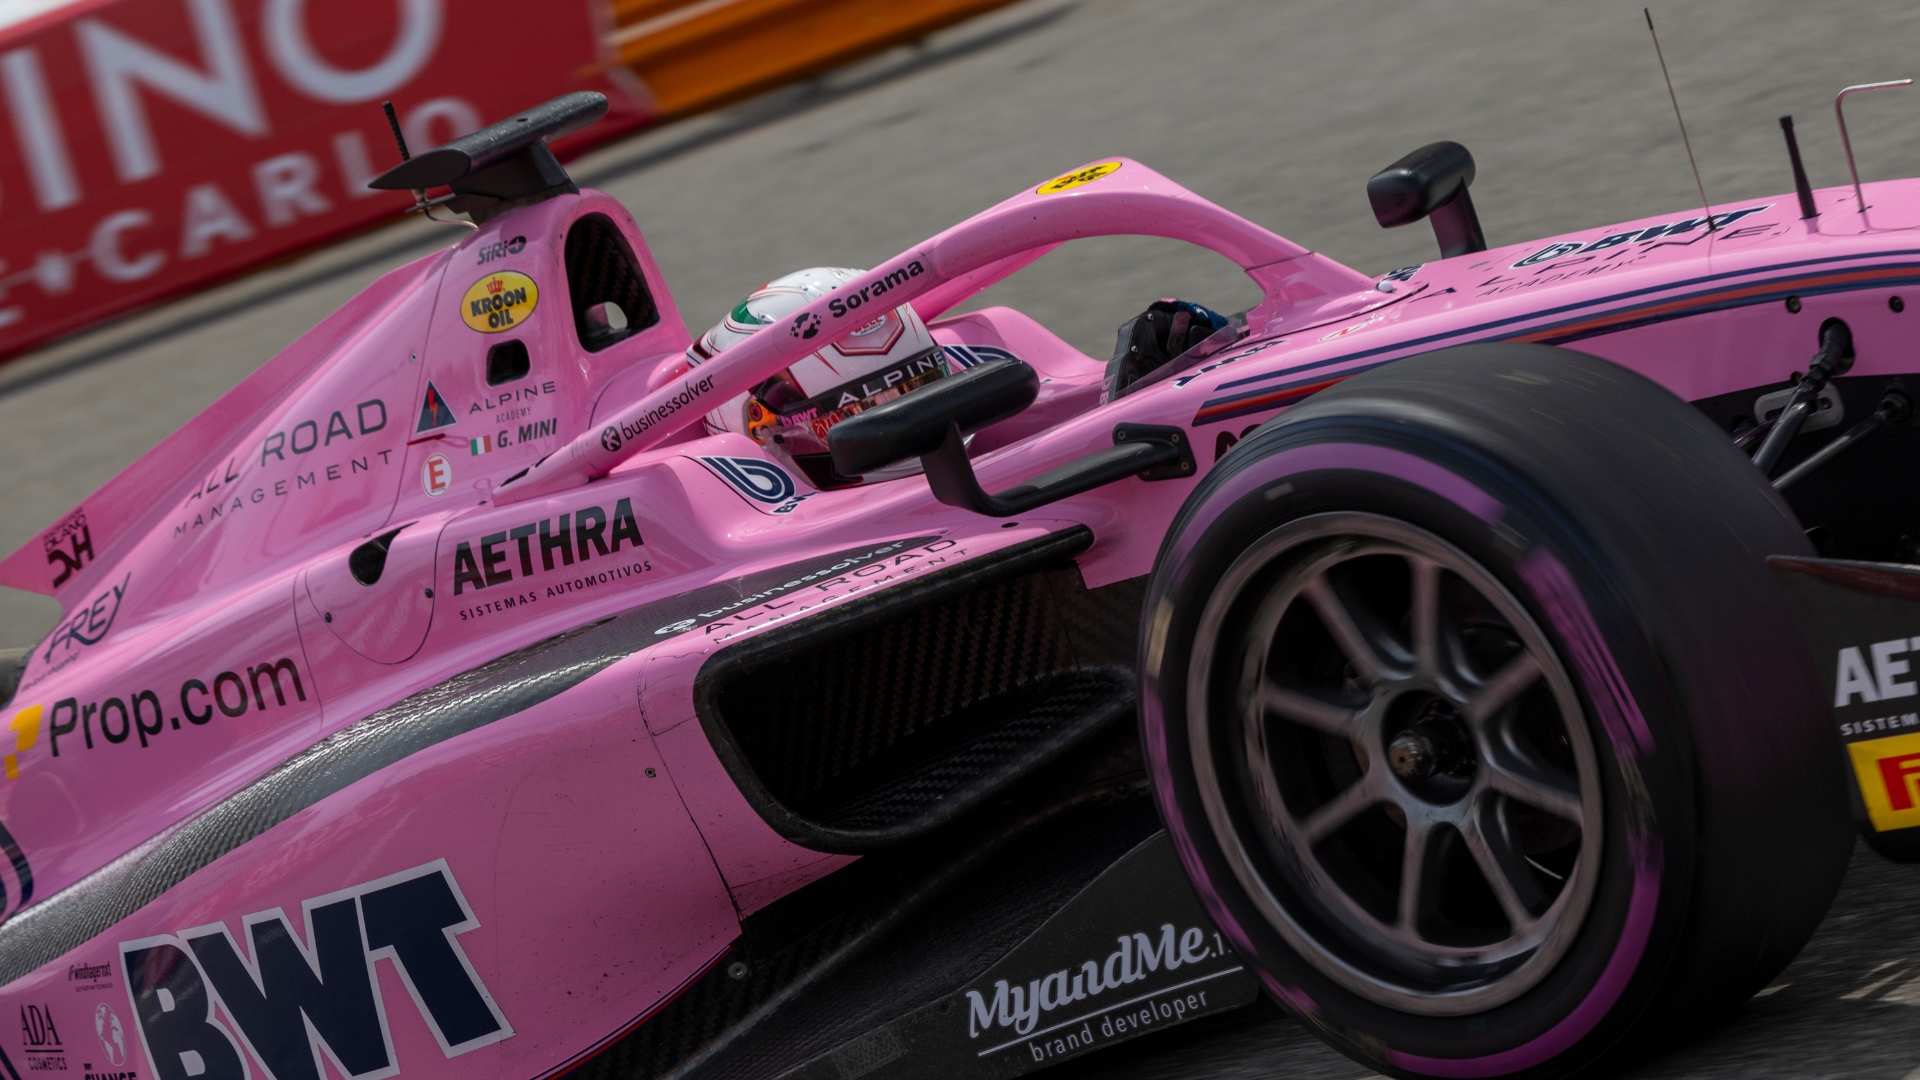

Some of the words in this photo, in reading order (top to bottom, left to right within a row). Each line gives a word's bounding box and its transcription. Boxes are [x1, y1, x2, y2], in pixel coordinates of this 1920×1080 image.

[1573, 203, 1777, 256] BWT
[470, 286, 528, 317] KROON
[828, 259, 925, 318] Sorama
[488, 309, 514, 329] OIL
[469, 381, 556, 414] ALPINE
[620, 374, 715, 441] businessolver
[837, 351, 944, 409] ALPINE
[260, 398, 388, 468] ROAD
[496, 406, 532, 424] ACADEMY
[497, 429, 514, 448] G.
[518, 418, 558, 445] MINI
[791, 407, 818, 426] BWT
[173, 449, 393, 540] MANAGEMENT
[428, 459, 446, 491] E
[453, 497, 645, 597] AETHRA
[459, 591, 537, 621] SISTEMAS
[546, 560, 653, 598] AUTOMOTIVOS
[698, 540, 905, 618] businessolver
[705, 600, 795, 636] ALL
[815, 539, 958, 592] ROAD
[120, 862, 510, 1080] BWT
[20, 1003, 62, 1046] ADA
[1028, 1023, 1094, 1063] brand
[1102, 990, 1208, 1038] developer
[28, 1057, 68, 1071] COSMETICS
